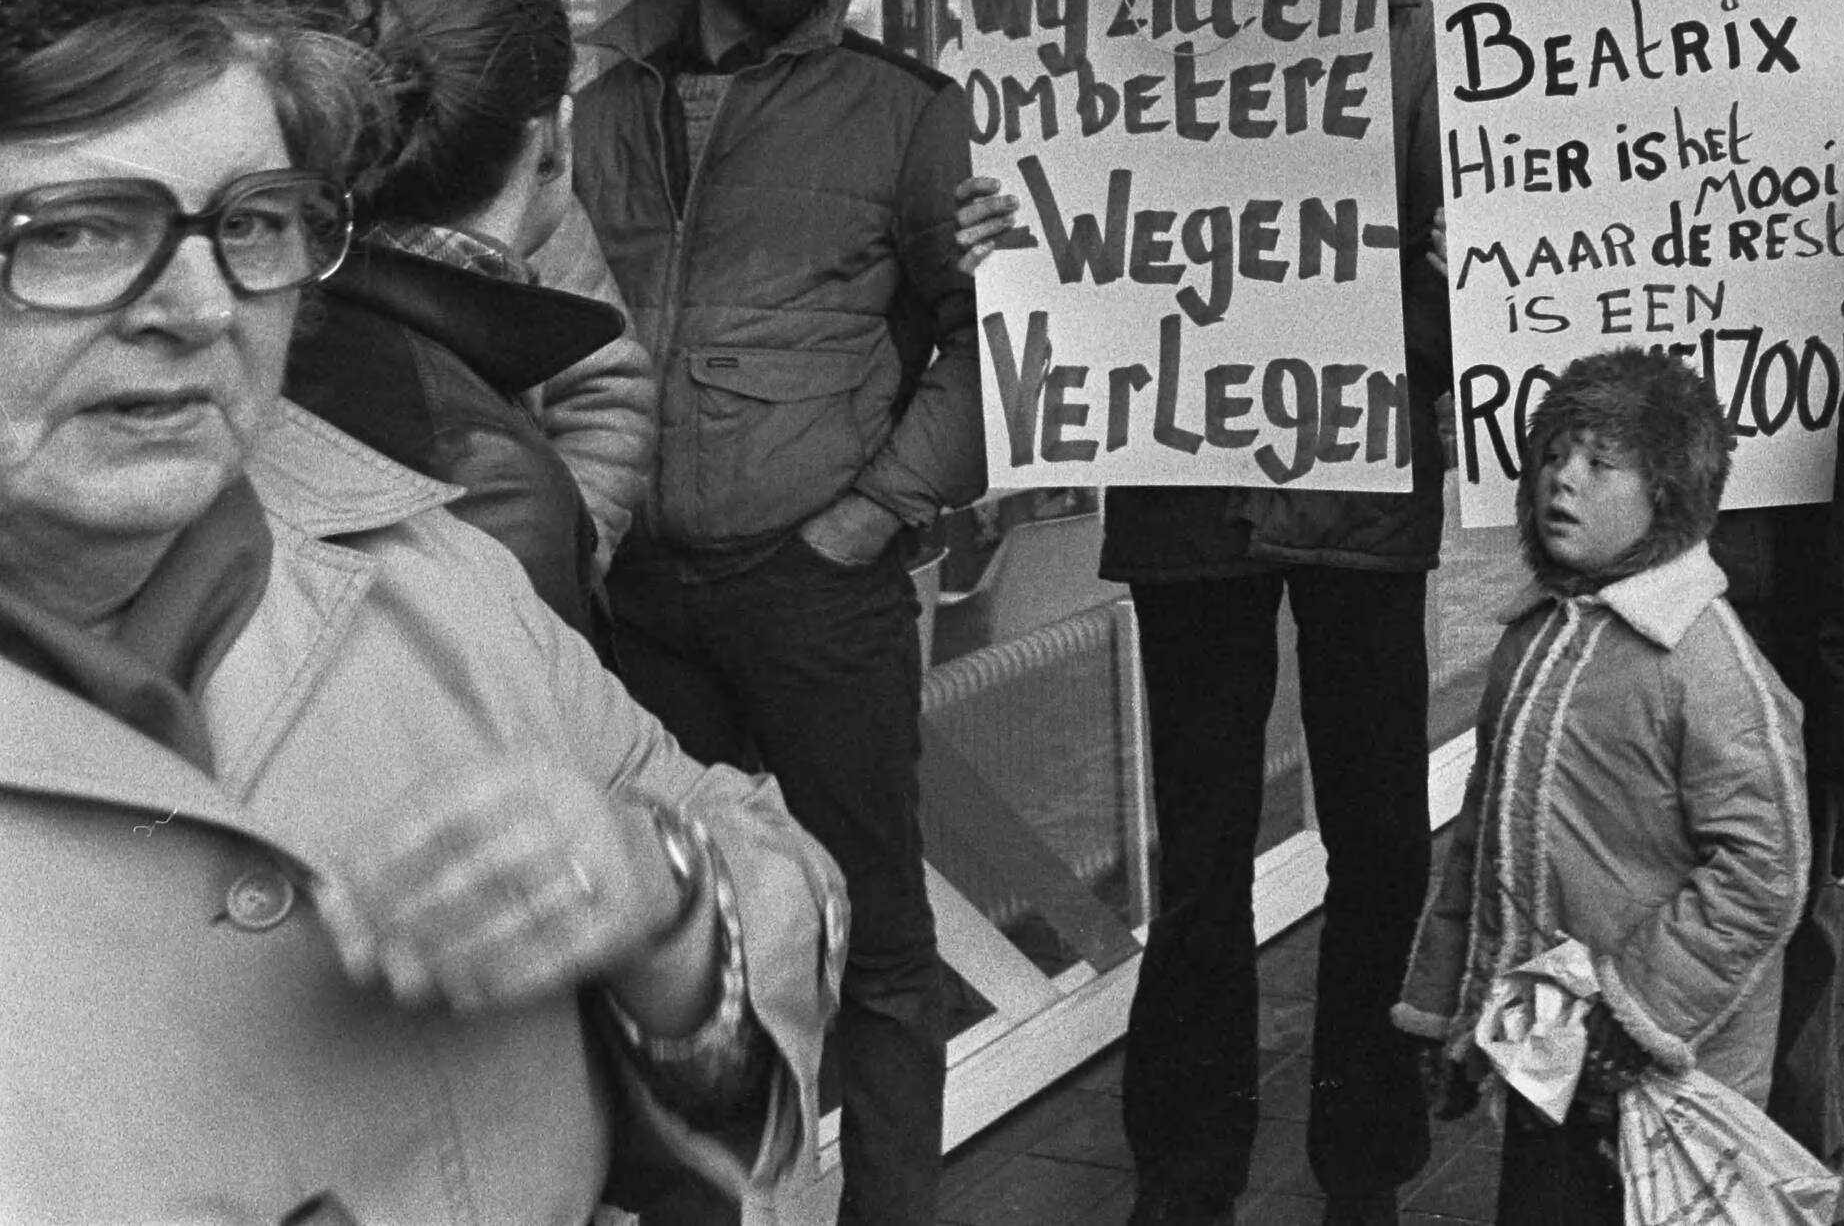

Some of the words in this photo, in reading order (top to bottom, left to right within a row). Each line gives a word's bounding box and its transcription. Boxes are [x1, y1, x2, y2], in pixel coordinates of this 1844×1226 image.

[966, 68, 1059, 145] OM
[1456, 222, 1636, 291] MAAR
[1597, 280, 1725, 334] EEN
